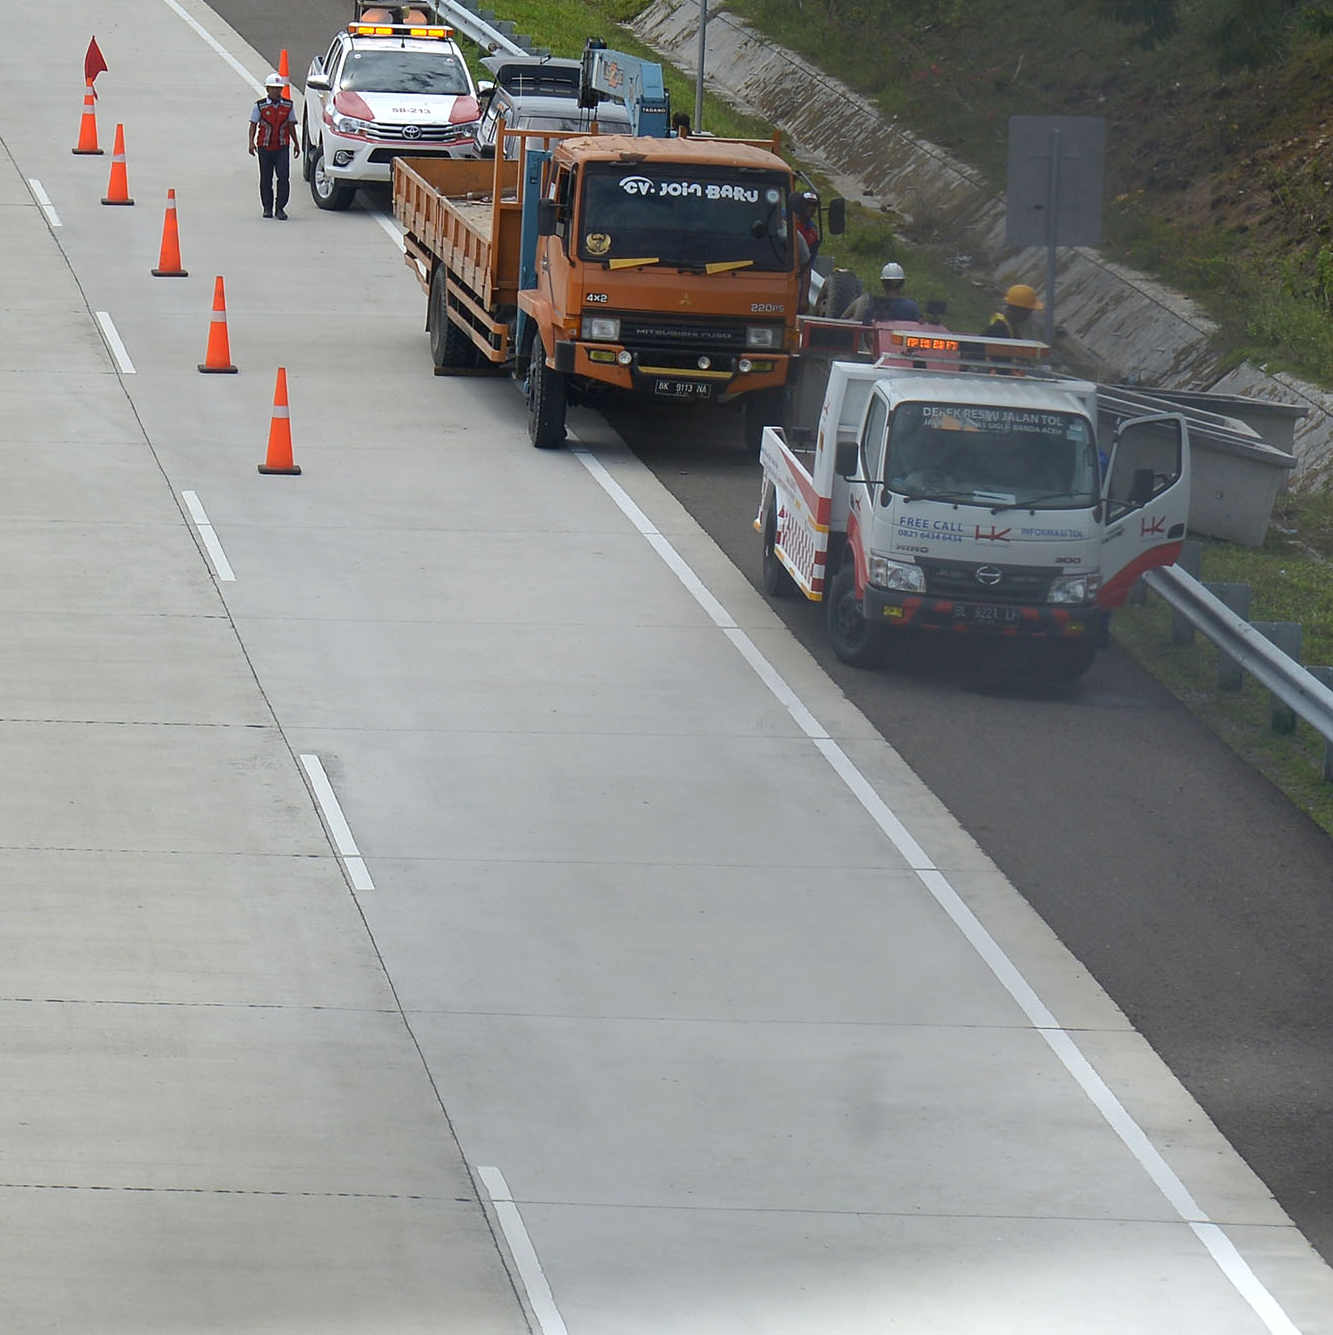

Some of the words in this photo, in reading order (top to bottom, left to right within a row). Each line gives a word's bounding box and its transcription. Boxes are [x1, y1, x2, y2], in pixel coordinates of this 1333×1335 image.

[750, 303, 784, 313] 220PS
[636, 329, 699, 338] MITSUBISHI
[676, 383, 693, 393] 9113
[696, 384, 707, 394] NA
[1001, 412, 1039, 424] JALAN
[1041, 415, 1064, 426] TOL
[900, 516, 929, 529] FREE
[933, 520, 963, 532] CALL
[898, 529, 918, 538] 0821
[1021, 528, 1067, 537] INFORMASI
[896, 545, 929, 553] HINO
